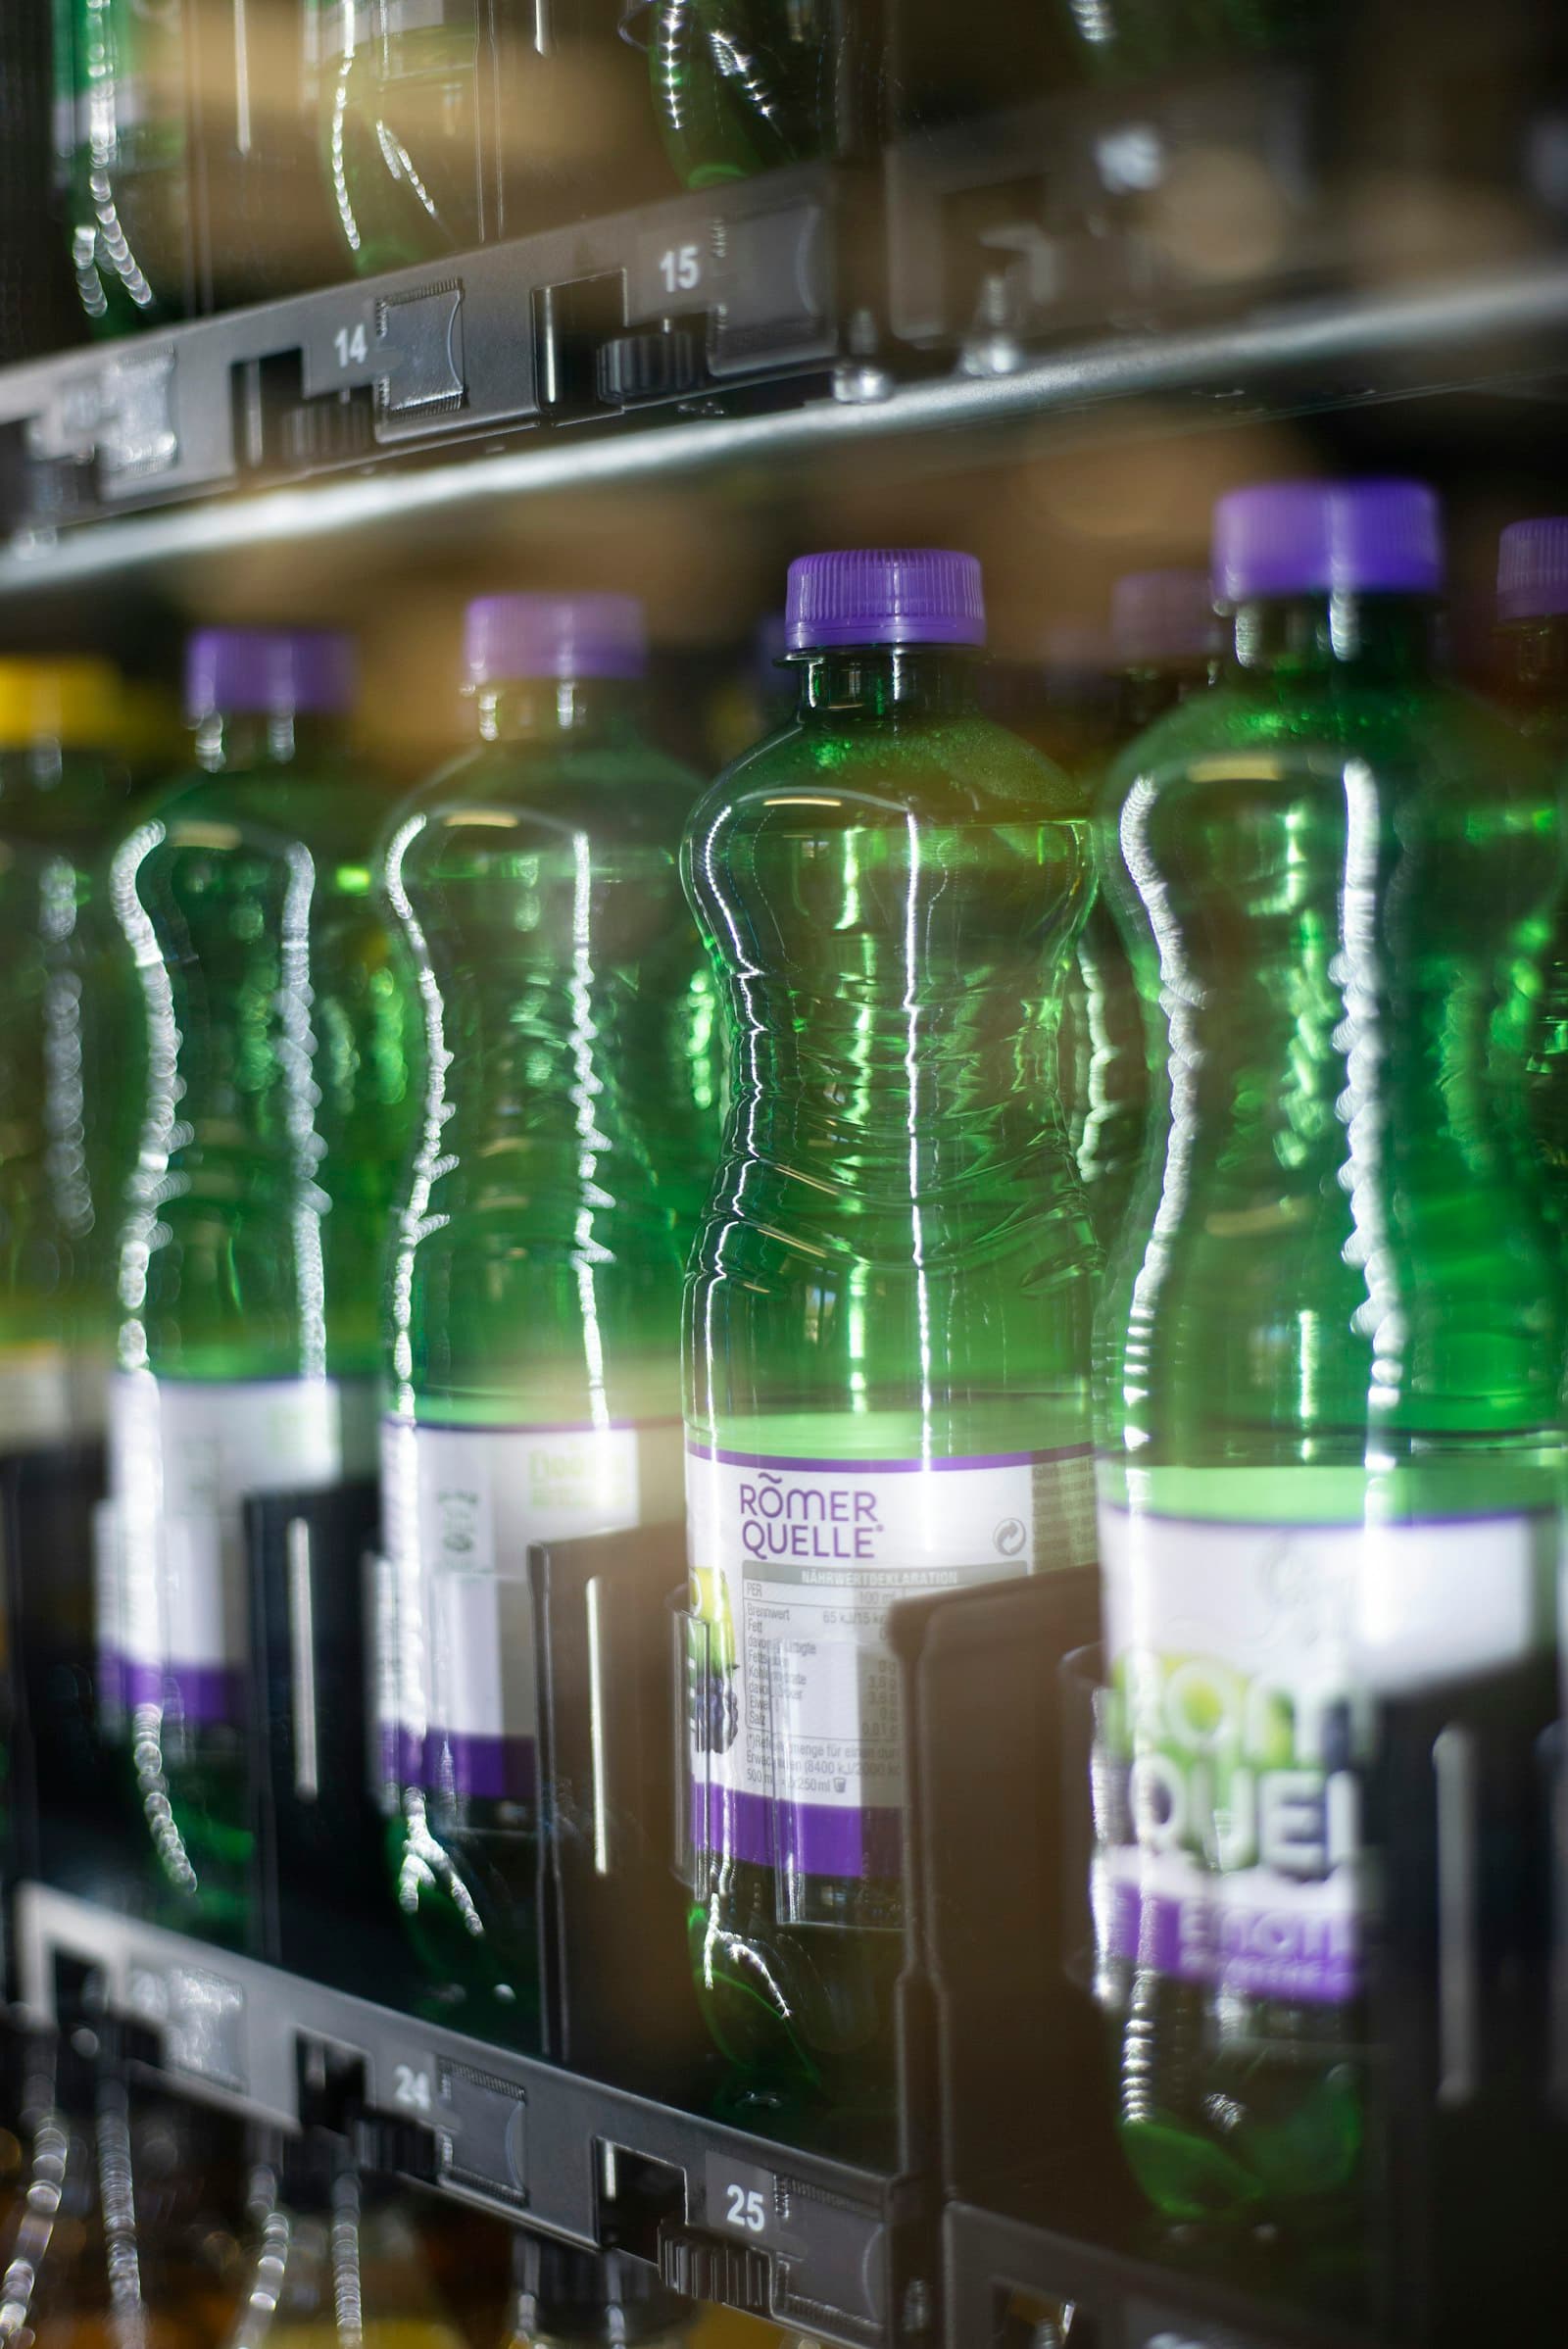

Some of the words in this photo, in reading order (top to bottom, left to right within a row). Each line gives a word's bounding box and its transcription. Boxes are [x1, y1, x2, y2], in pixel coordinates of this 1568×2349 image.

[661, 246, 699, 292] 15
[334, 324, 368, 367] 14
[746, 1583, 762, 1597] PER
[747, 1602, 790, 1622] Brennwert
[747, 1620, 762, 1634] Fett
[748, 1768, 762, 1783] 500
[393, 2064, 431, 2110] 24
[727, 2183, 764, 2232] 25
